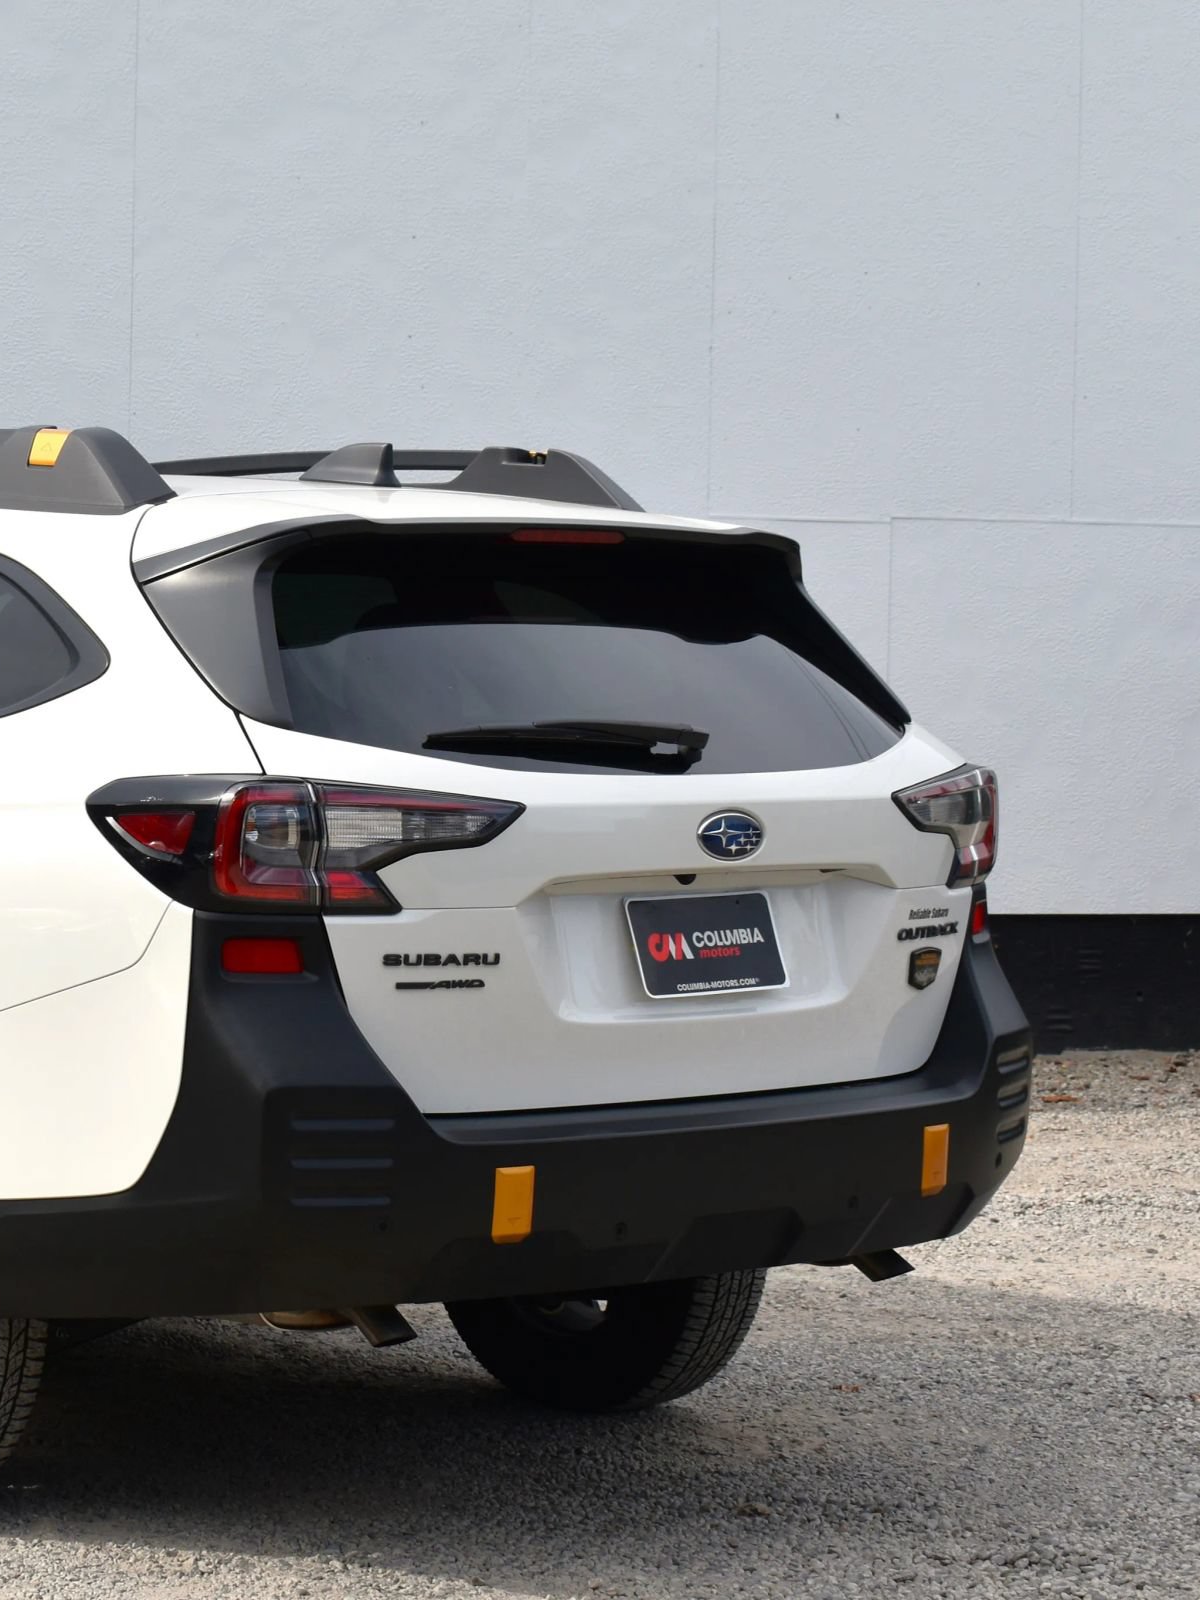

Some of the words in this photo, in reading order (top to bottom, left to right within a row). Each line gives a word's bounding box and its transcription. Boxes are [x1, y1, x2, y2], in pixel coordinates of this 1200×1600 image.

[909, 909, 931, 920] Reliable
[931, 907, 949, 919] Subaru
[692, 927, 765, 948] COLUMBIA
[897, 921, 958, 941] OUTBACK
[699, 946, 741, 959] motors
[382, 953, 501, 967] SUBARU
